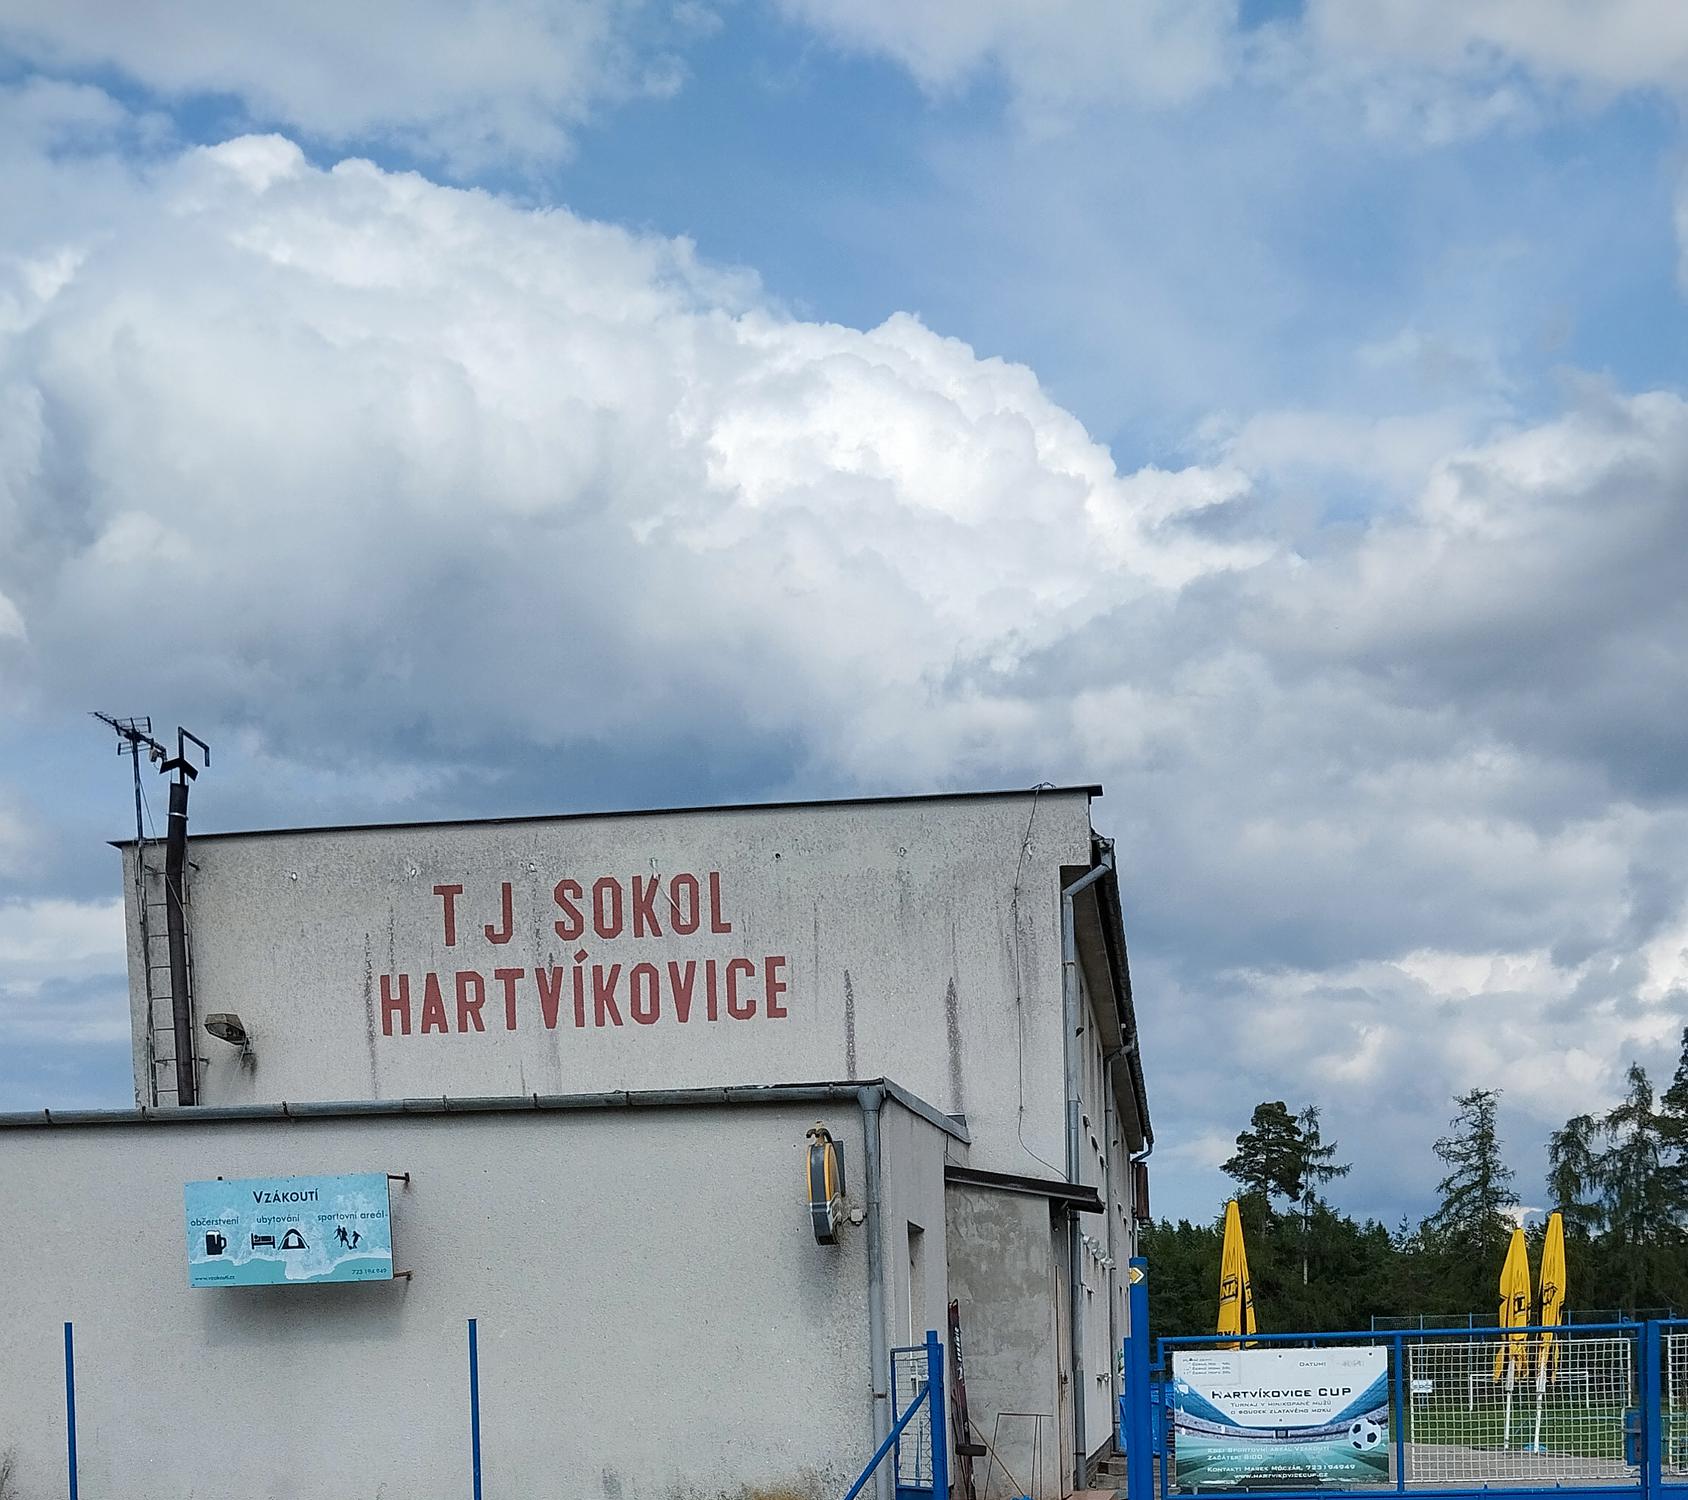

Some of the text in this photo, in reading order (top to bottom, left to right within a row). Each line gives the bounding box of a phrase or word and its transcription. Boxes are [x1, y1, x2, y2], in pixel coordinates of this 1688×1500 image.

[554, 871, 731, 942] SOKOL
[380, 948, 787, 1036] HARTVÍKOVICE
[190, 1216, 239, 1226] občerstvení
[256, 1213, 300, 1225] ubytování
[317, 1211, 357, 1222] sportovní
[1211, 1387, 1352, 1399] HARTVÍKOVICE CUP
